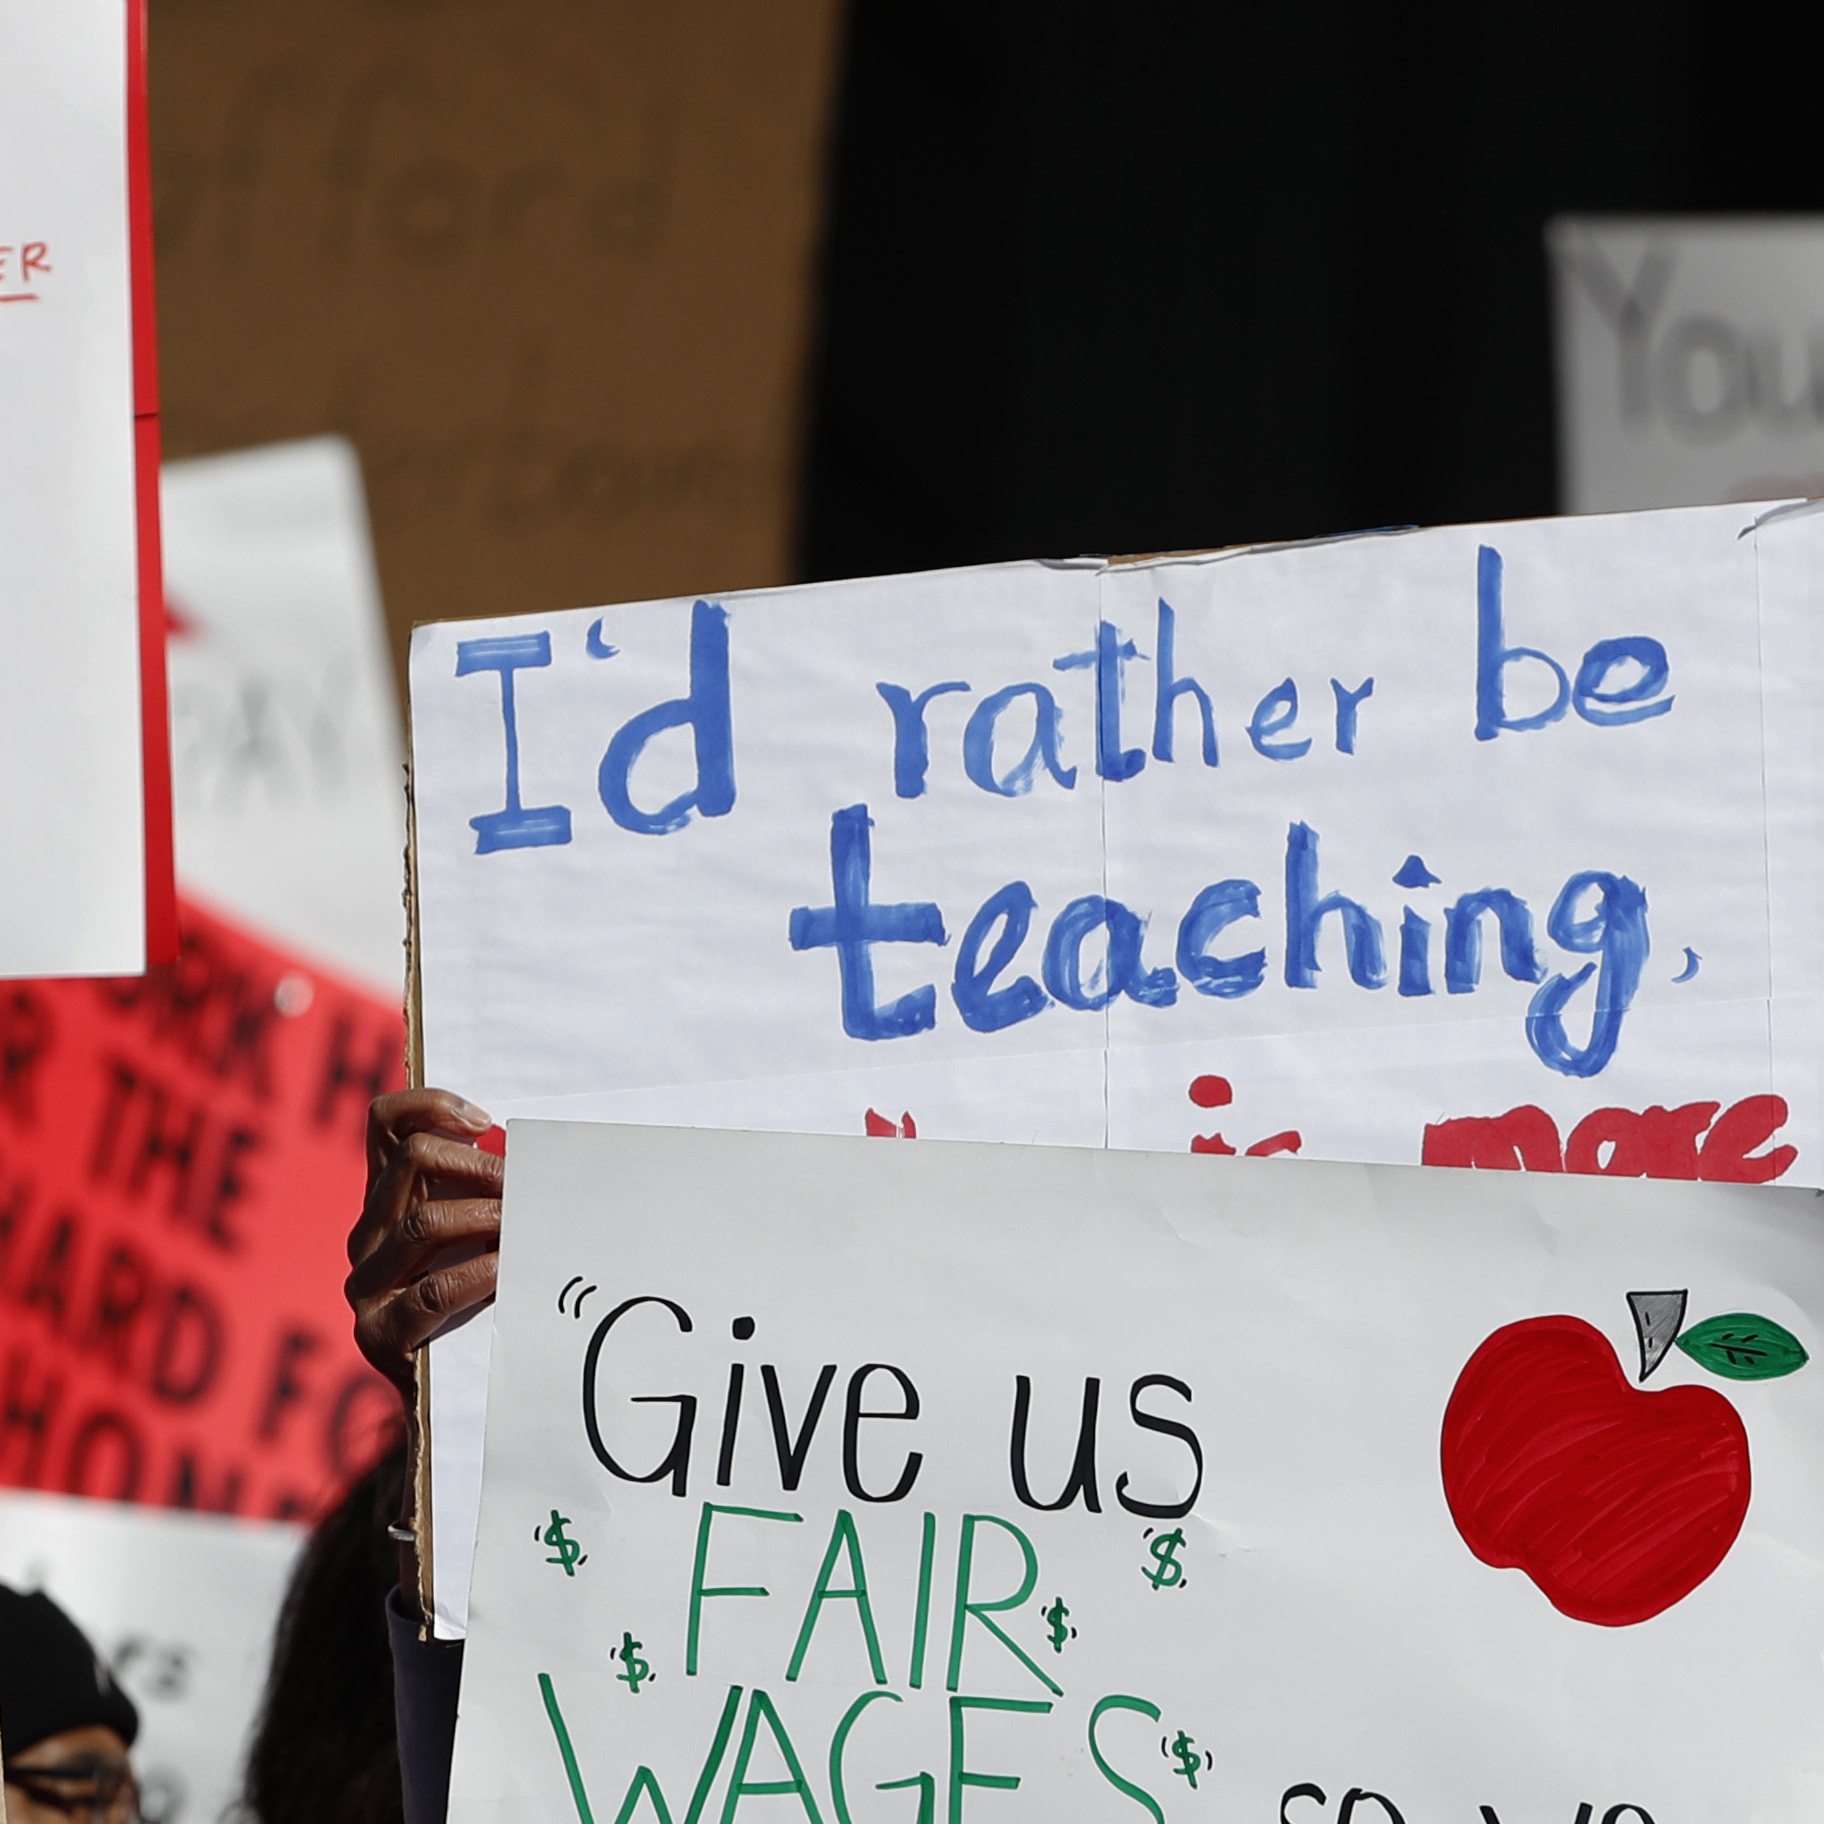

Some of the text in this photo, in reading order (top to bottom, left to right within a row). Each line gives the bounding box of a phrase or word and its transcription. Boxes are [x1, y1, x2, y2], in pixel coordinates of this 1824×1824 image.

[455, 544, 1676, 856] I'd rather be
[788, 802, 1702, 1079] teaching,
[1009, 1372, 1205, 1520] us
[685, 1501, 1065, 1698] FAIR
